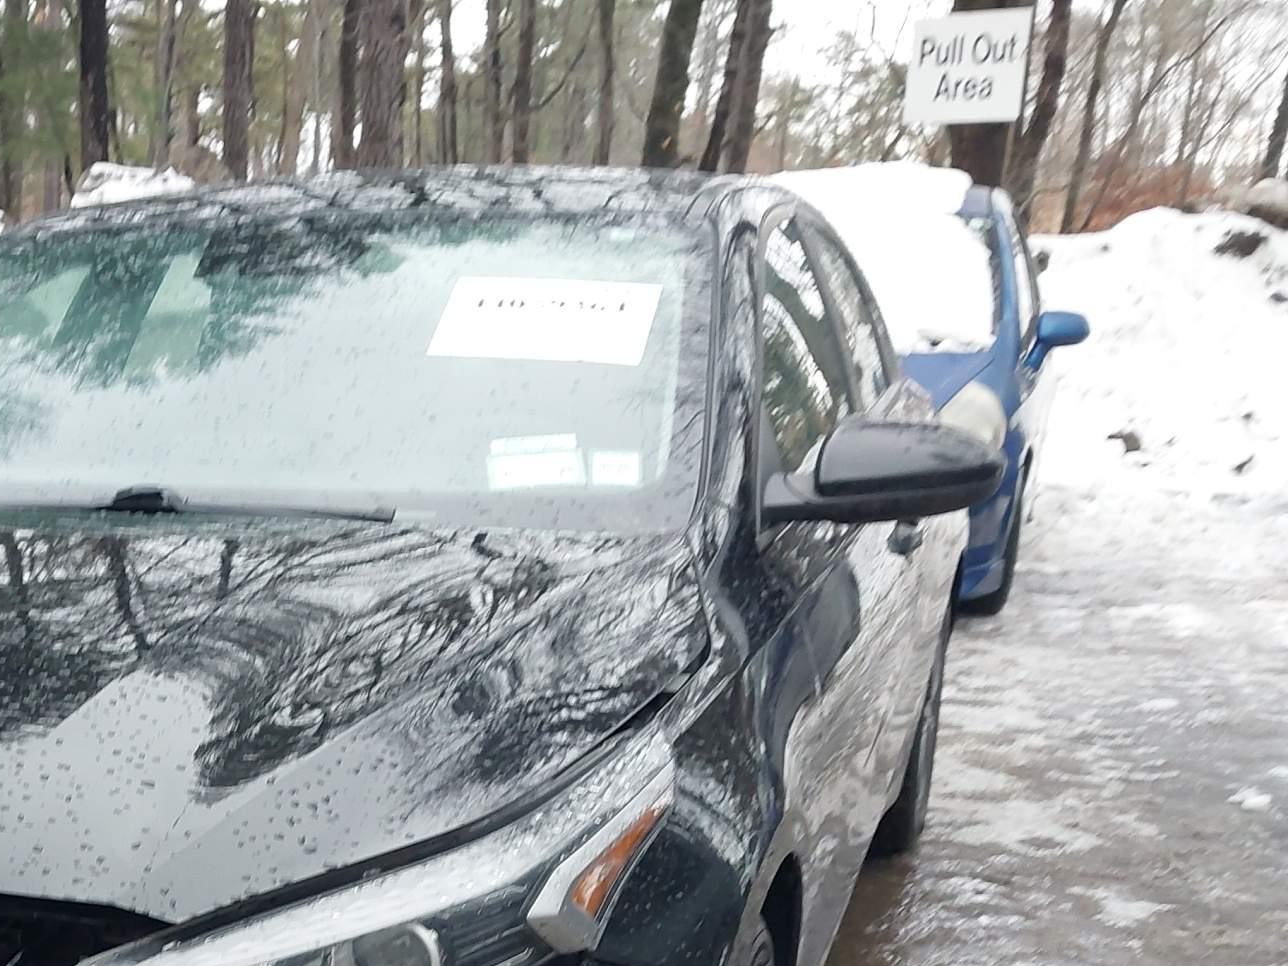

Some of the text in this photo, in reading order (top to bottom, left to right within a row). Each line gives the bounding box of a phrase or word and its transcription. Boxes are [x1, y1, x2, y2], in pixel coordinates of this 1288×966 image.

[919, 33, 1017, 66] Pull Out
[933, 73, 994, 102] Area
